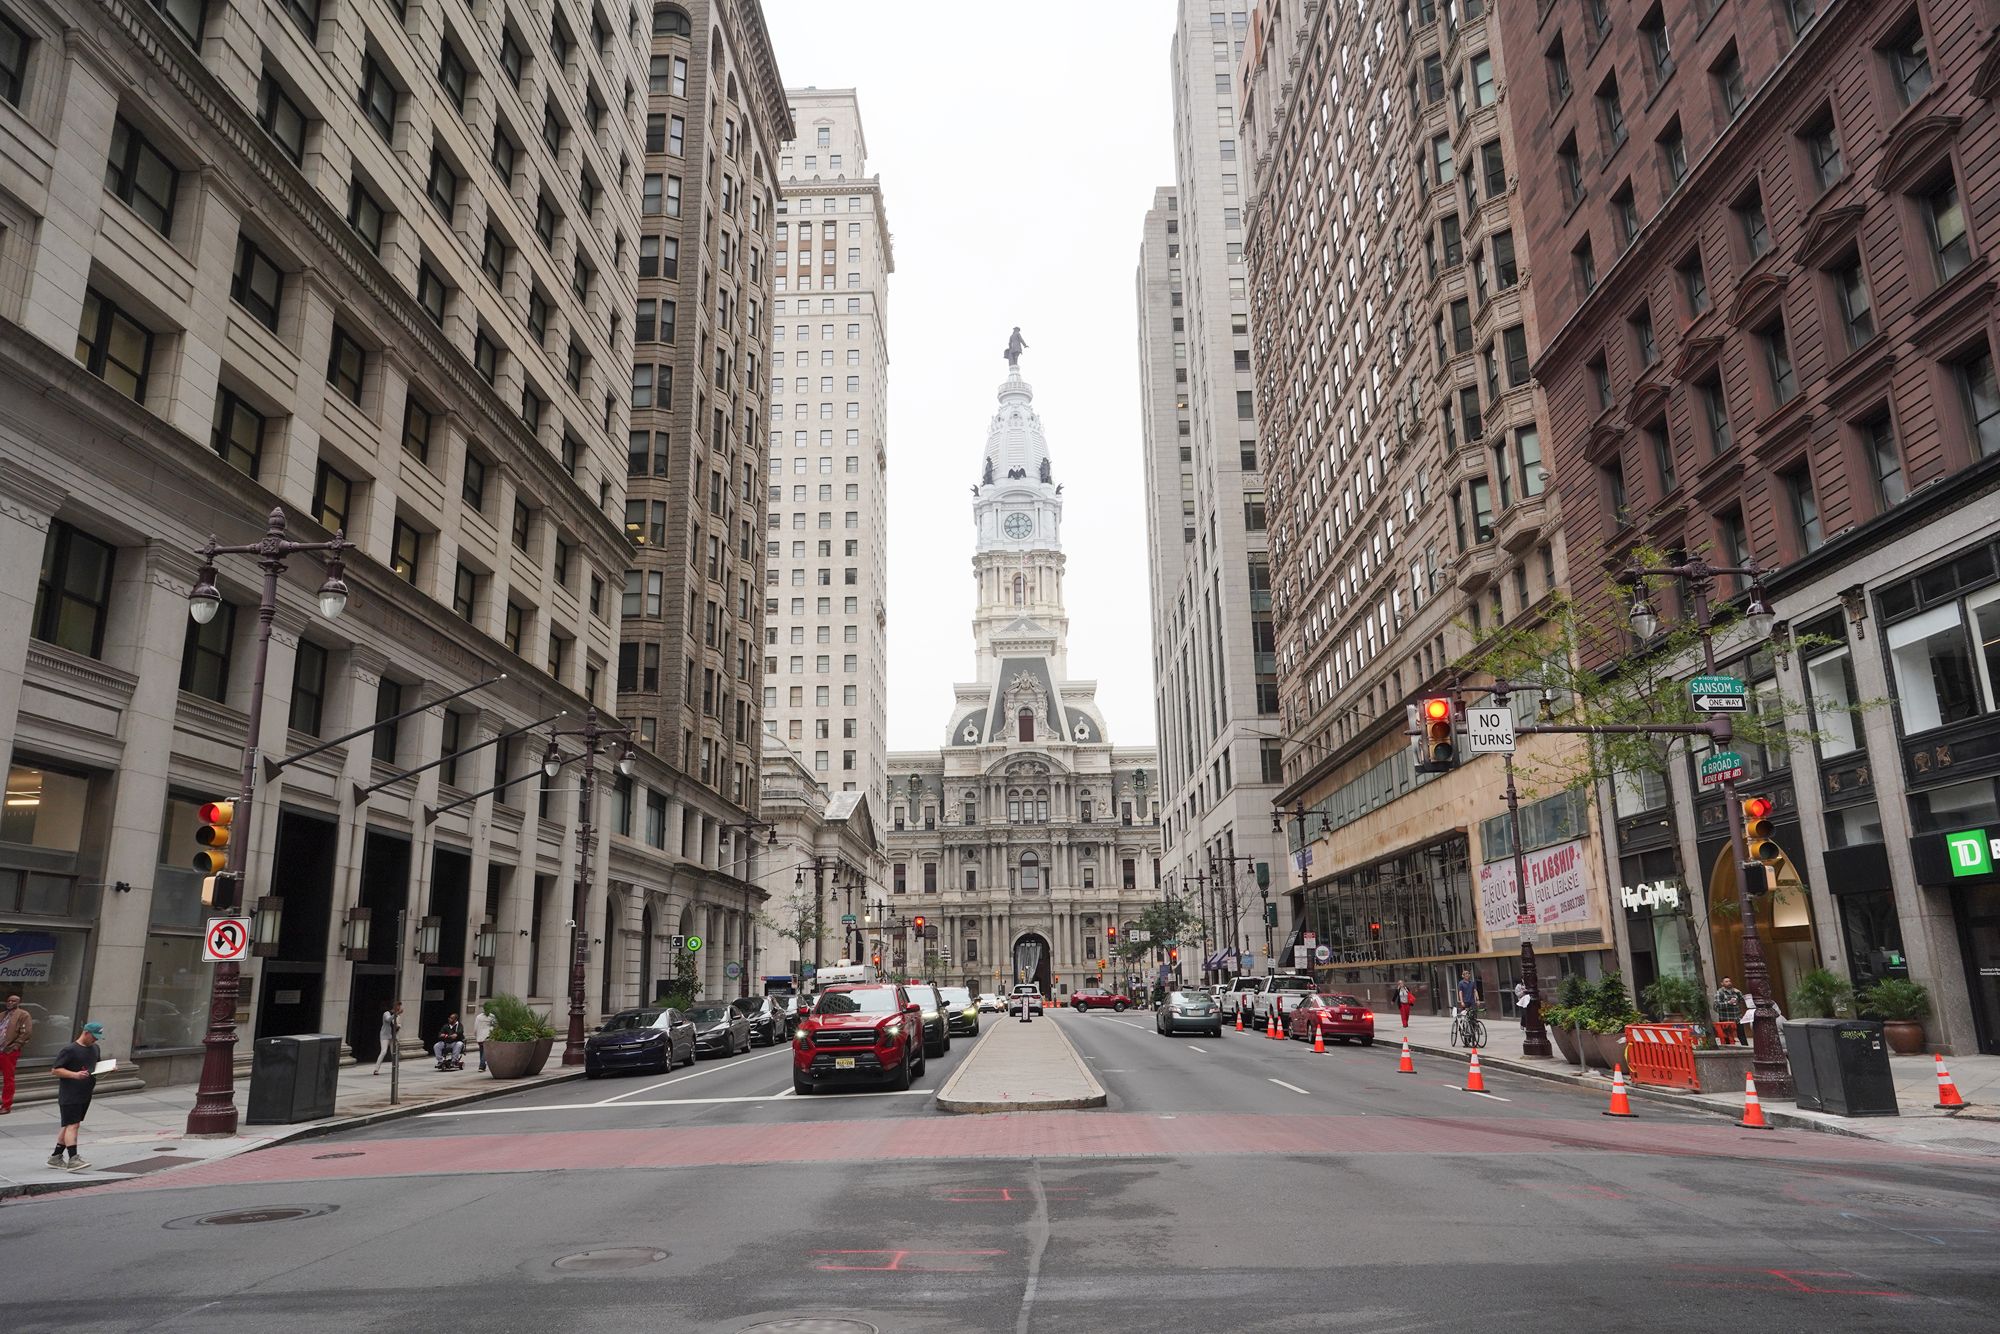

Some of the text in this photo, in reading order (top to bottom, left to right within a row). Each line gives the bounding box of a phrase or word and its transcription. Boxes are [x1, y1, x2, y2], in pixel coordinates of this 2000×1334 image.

[1692, 682, 1743, 693] SANSOM ST
[1479, 713, 1500, 728] NO
[1471, 733, 1513, 746] TURNS
[1708, 758, 1741, 774] BROAD ST
[1717, 772, 1724, 781] OF
[1732, 768, 1742, 778] ARTS
[1951, 838, 1982, 867] TD
[1480, 865, 1492, 881] MSC
[1531, 845, 1575, 886] FLAGSHIP
[1482, 877, 1507, 907] 7,500
[1535, 871, 1580, 904] FOR LEASE
[1620, 880, 1679, 913] HipCityVeg
[0, 967, 46, 977] Post Office
